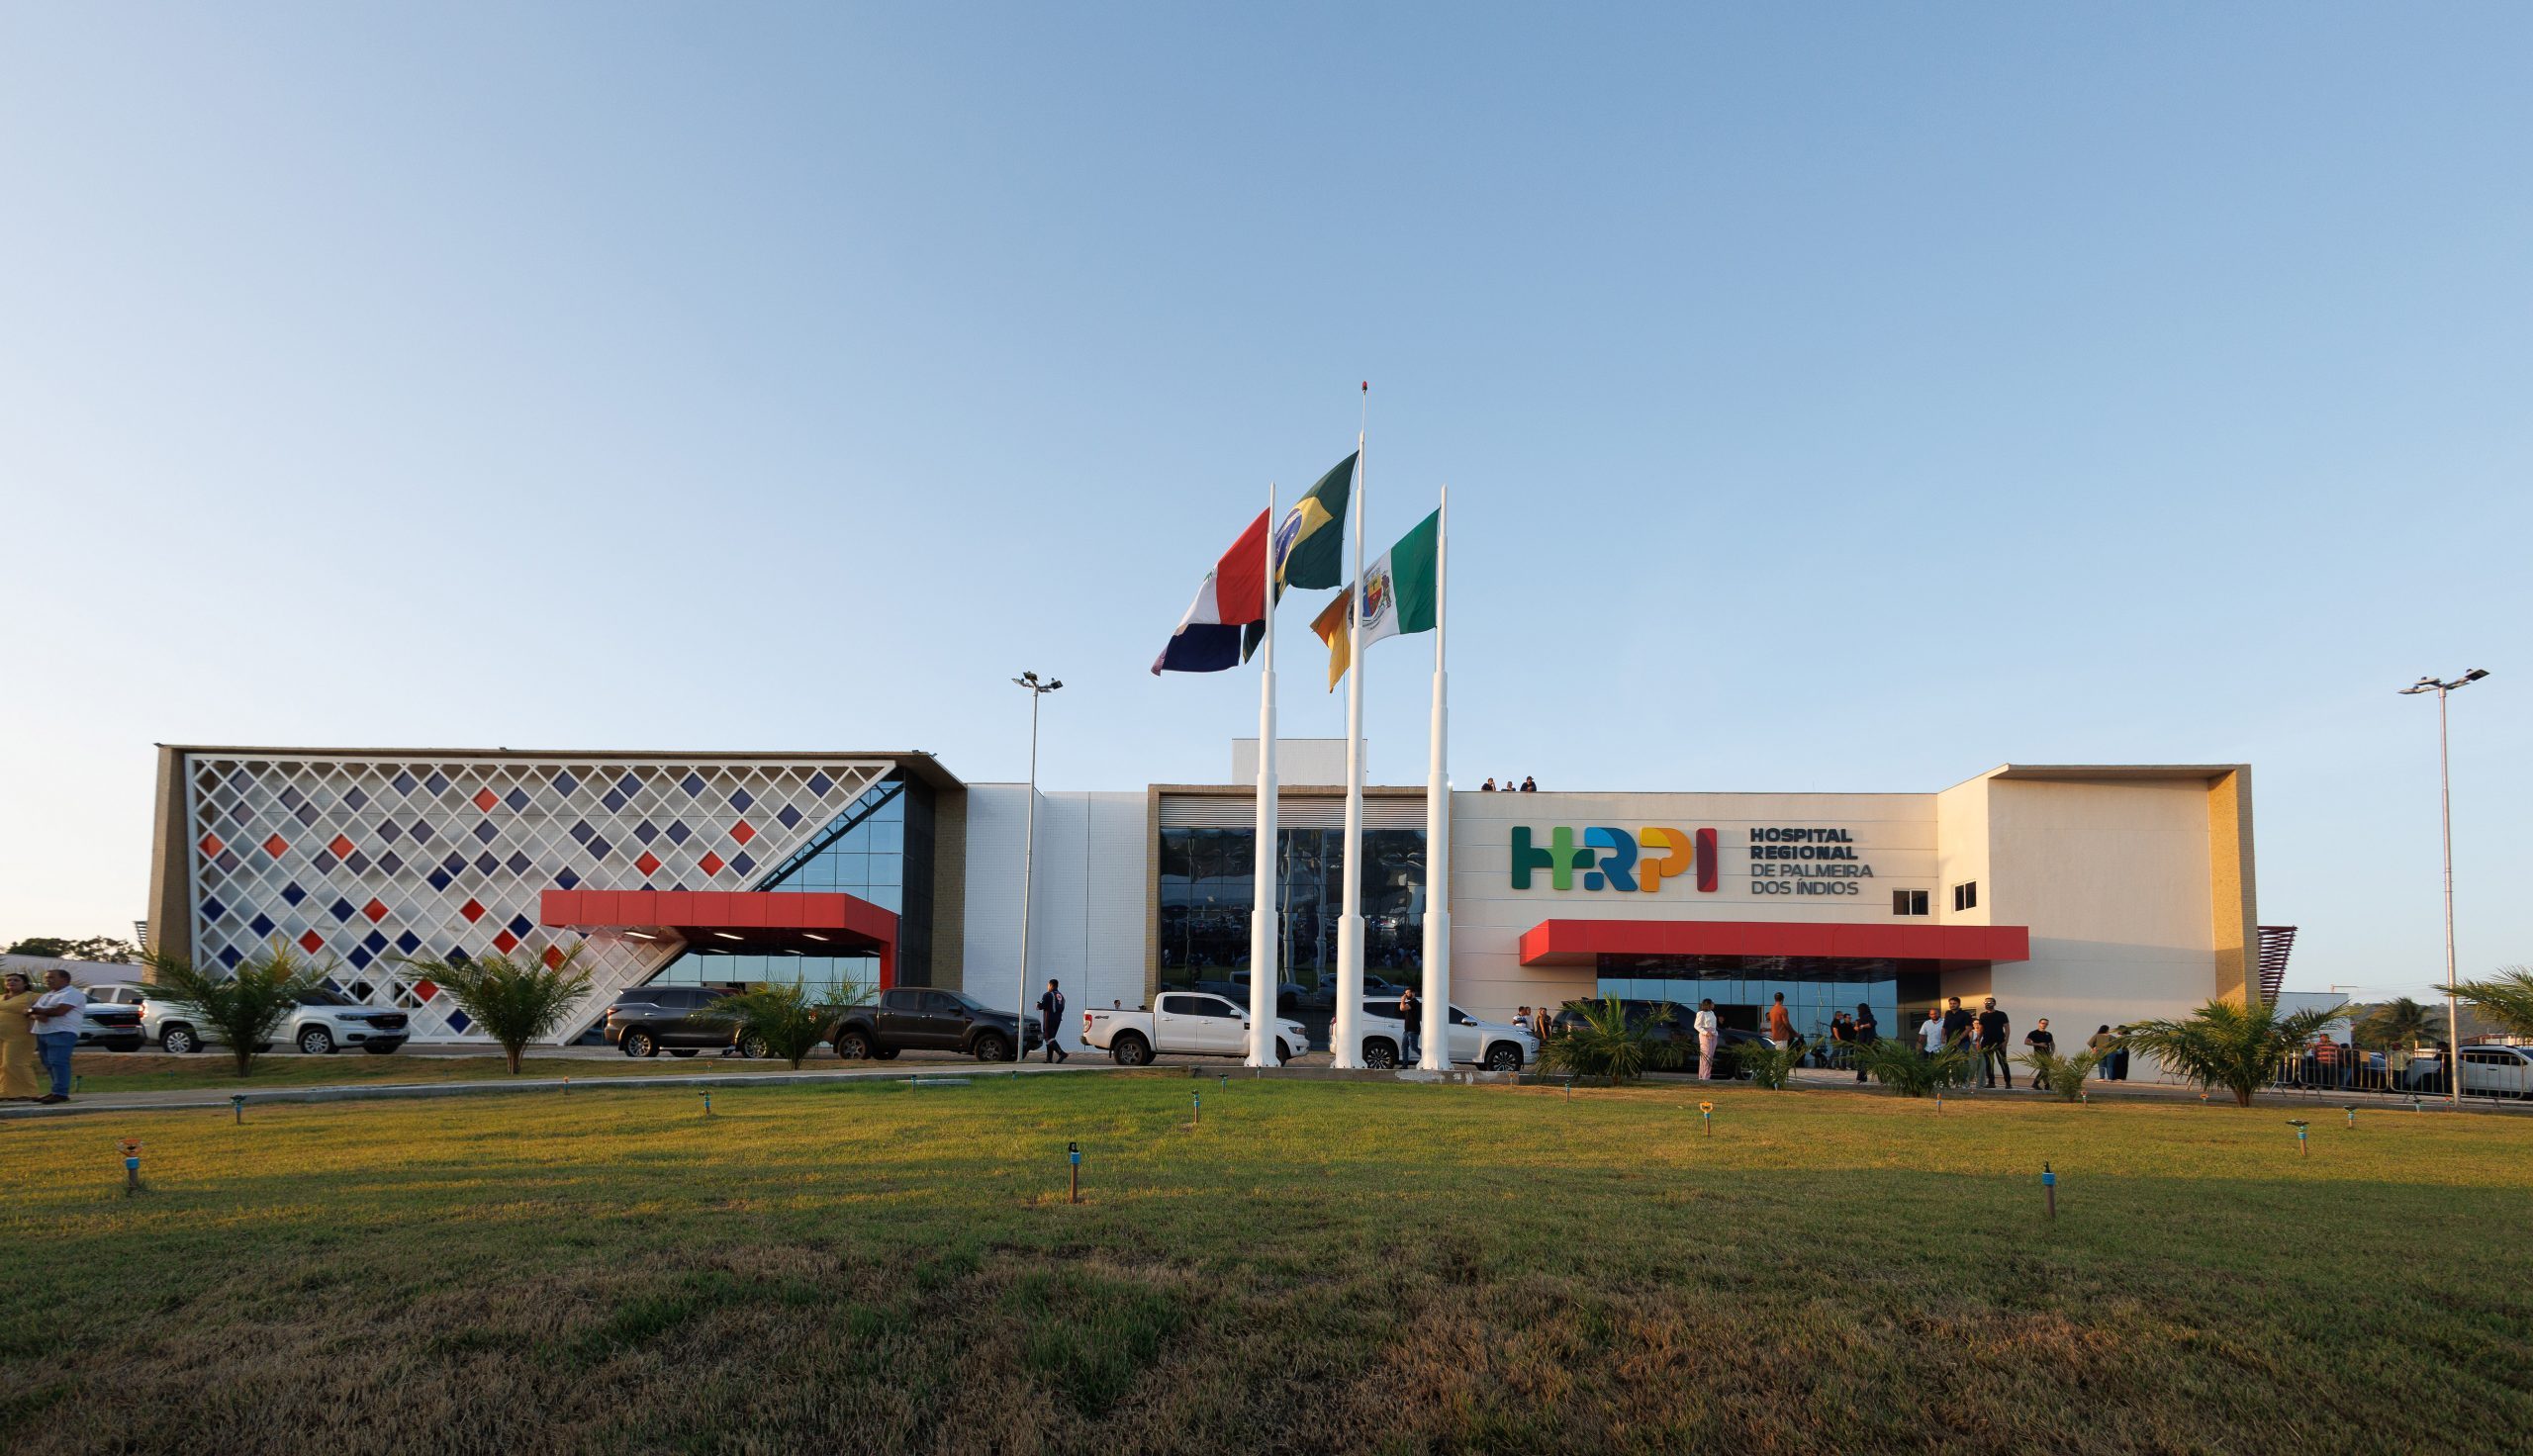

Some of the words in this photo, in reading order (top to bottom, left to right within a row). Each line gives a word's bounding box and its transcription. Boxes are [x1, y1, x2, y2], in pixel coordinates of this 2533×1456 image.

[1750, 828, 1853, 843] HOSPITAL
[1511, 826, 1718, 892] HRPI
[1750, 846, 1858, 860] REGIONAL
[1751, 864, 1776, 877] DE
[1780, 864, 1874, 877] PALMEIRA
[1751, 880, 1792, 895] DOS
[1797, 877, 1859, 895] ÍNDIOS
